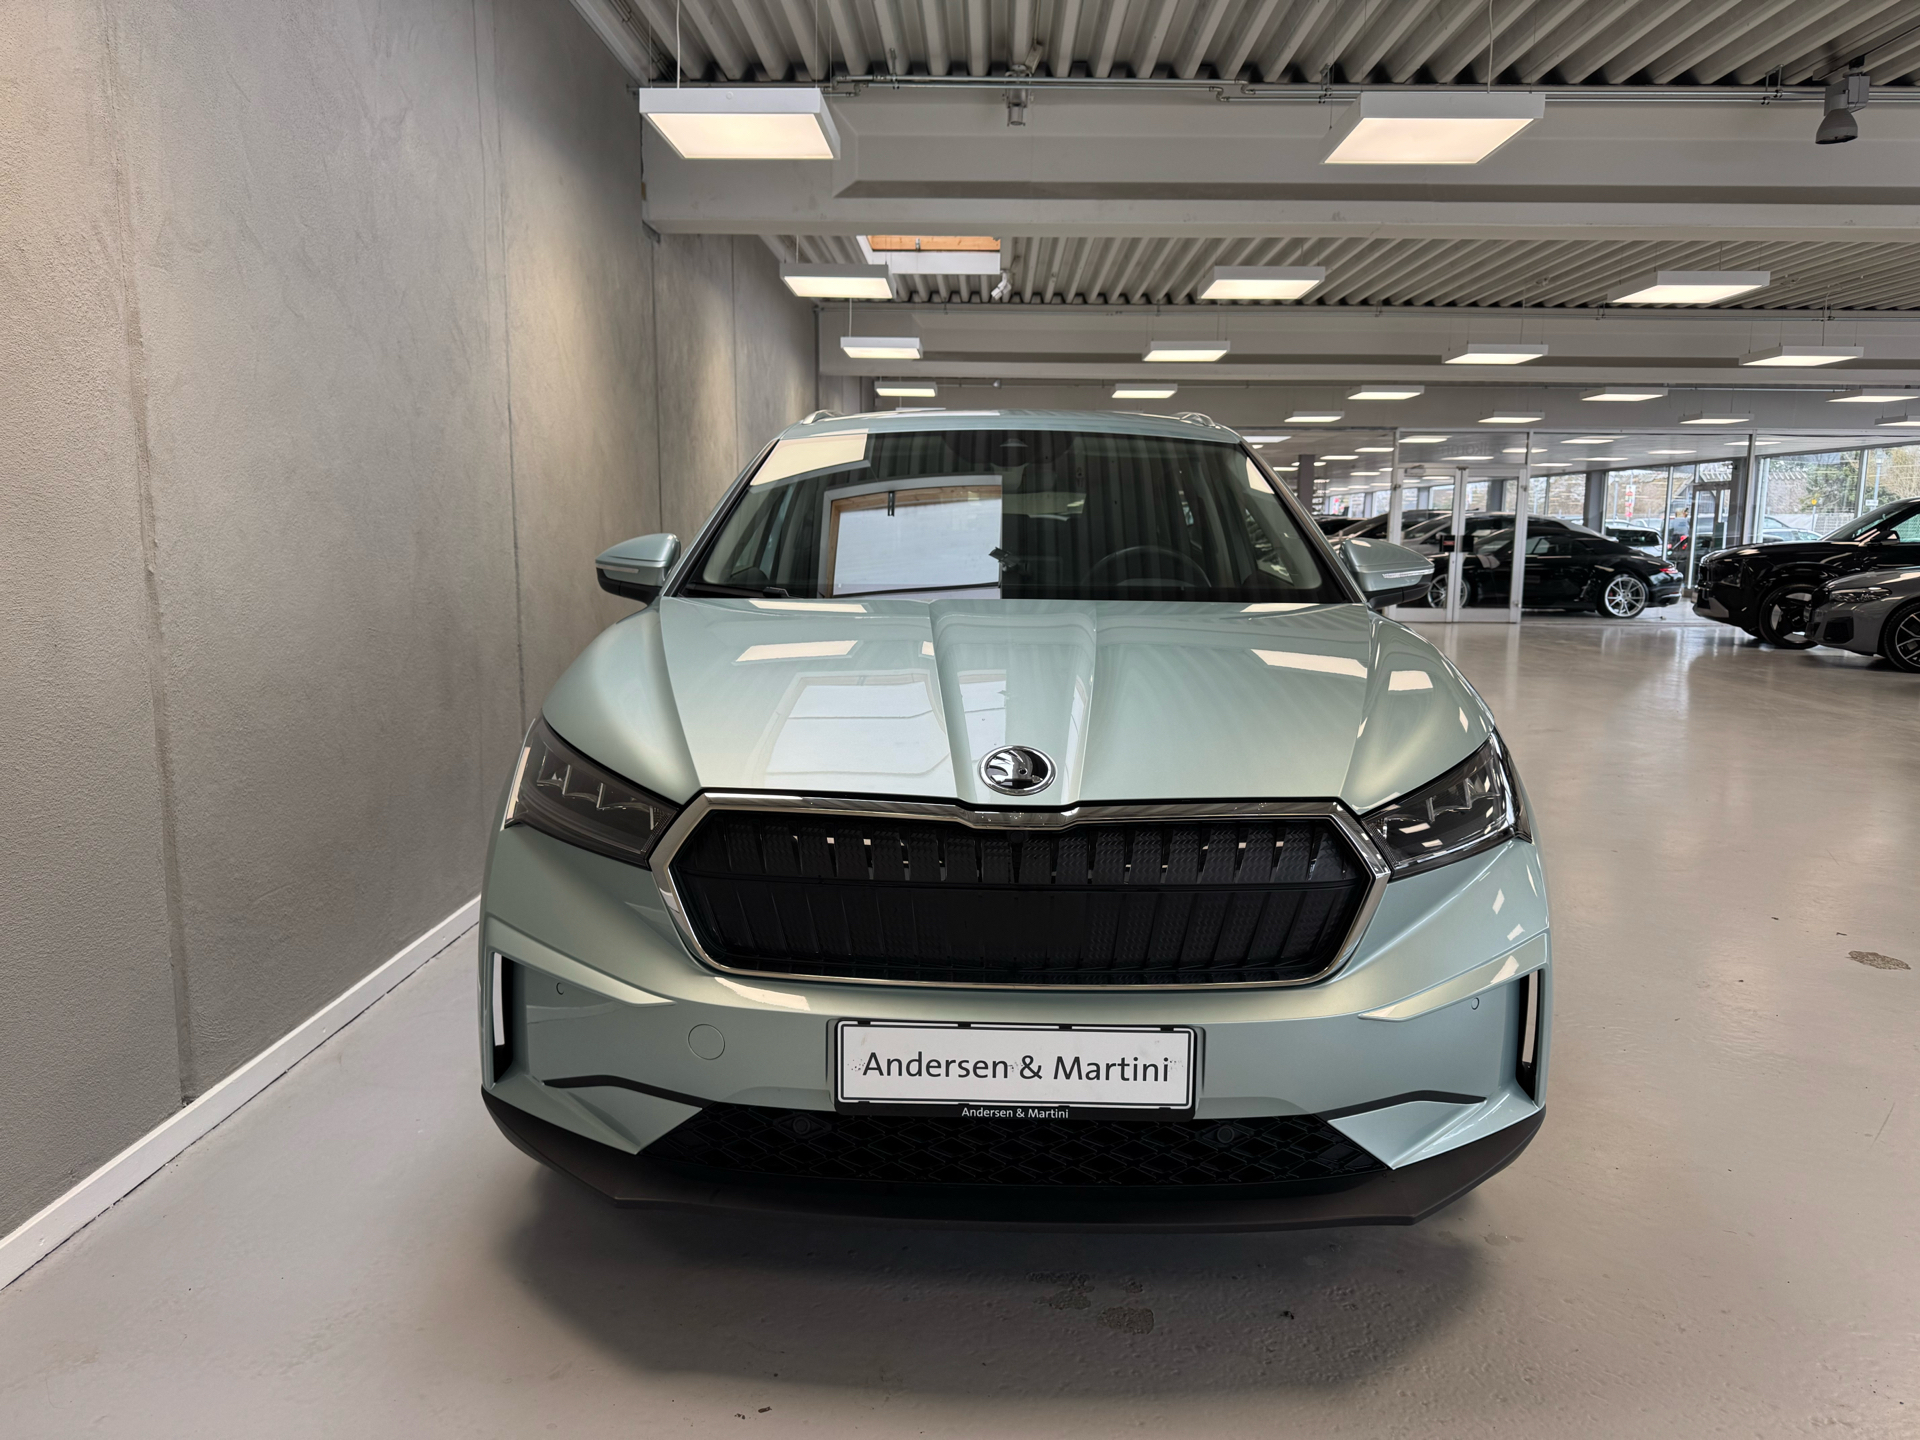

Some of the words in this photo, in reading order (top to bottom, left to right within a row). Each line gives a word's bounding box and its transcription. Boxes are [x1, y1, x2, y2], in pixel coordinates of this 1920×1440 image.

[862, 1051, 1009, 1079] Andersen
[1019, 1055, 1042, 1080] &
[1053, 1056, 1170, 1082] Martini
[961, 1107, 1013, 1118] Andersen
[1016, 1108, 1025, 1118] &
[1028, 1108, 1069, 1119] Martini
